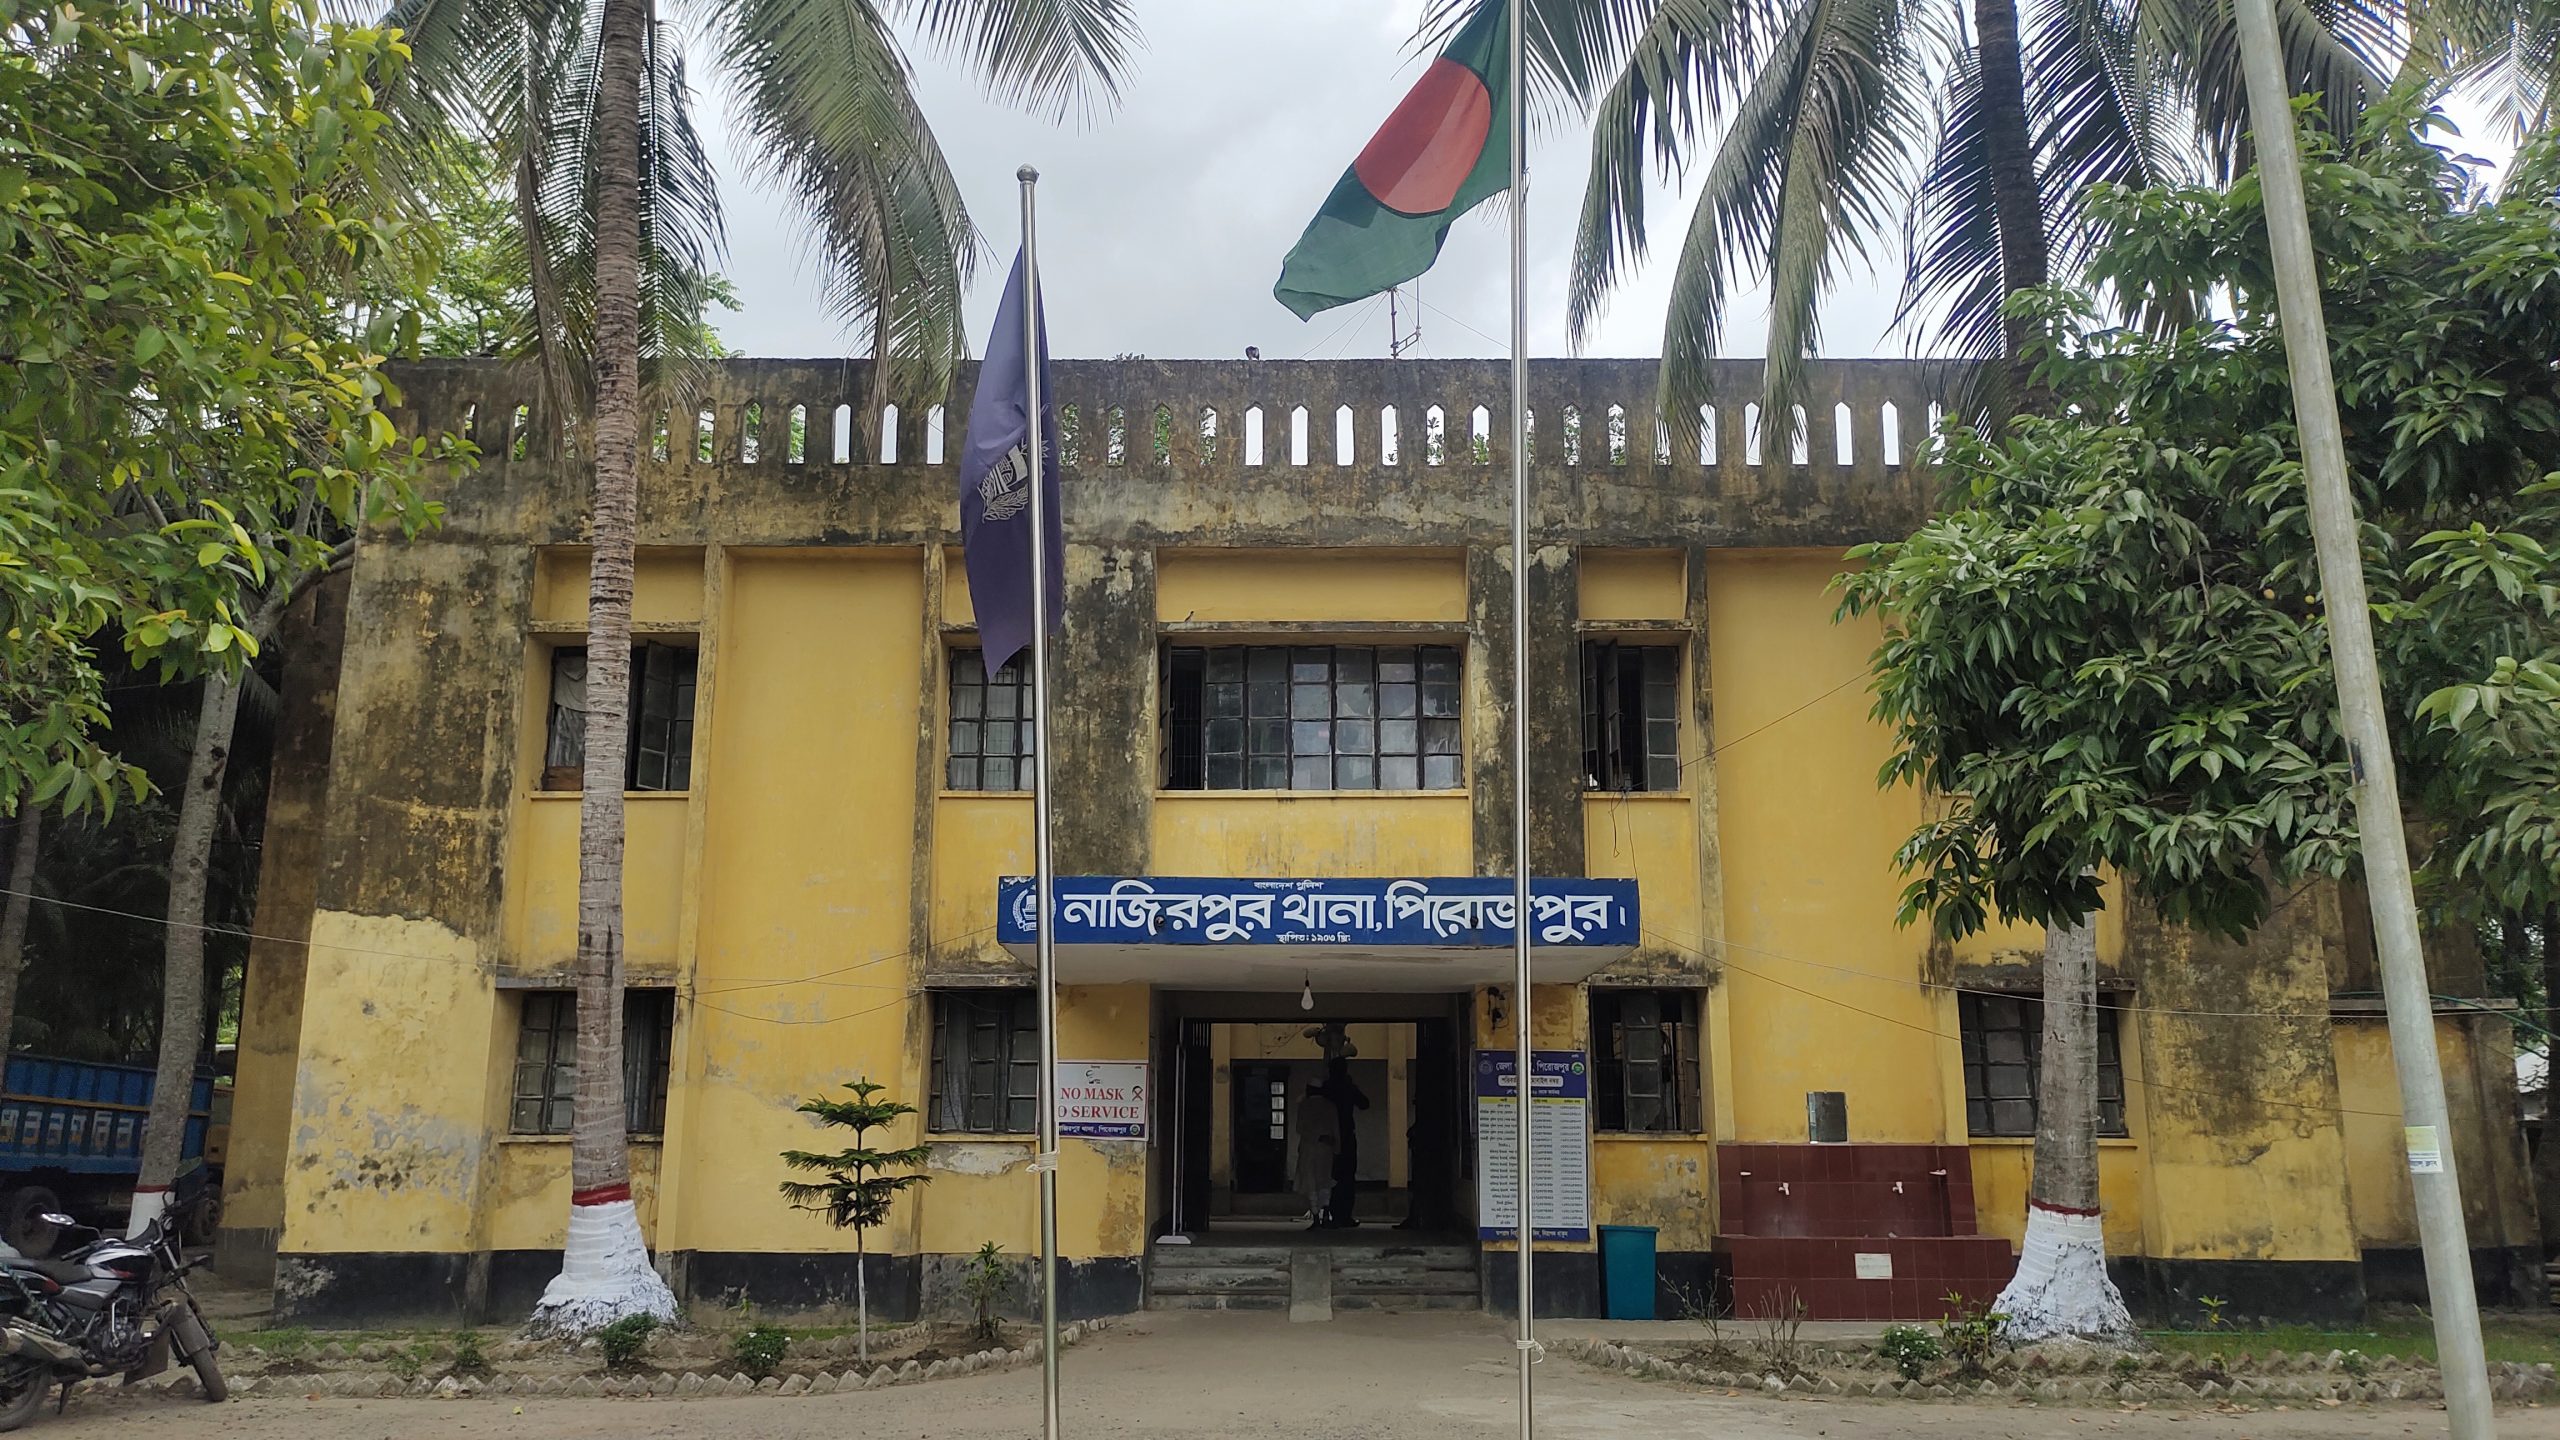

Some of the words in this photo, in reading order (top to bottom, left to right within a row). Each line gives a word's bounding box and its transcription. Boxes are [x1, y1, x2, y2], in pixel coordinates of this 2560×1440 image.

[1253, 881, 1294, 891] বাংলাদেশ
[1296, 879, 1325, 891] পুলিশ
[1062, 879, 1276, 941] নাজিরপুর
[1536, 1059, 1570, 1074] পিরোজপুর
[1061, 1087, 1081, 1100] NO
[1085, 1088, 1124, 1100] MASK
[1071, 1105, 1139, 1118] SERVICE
